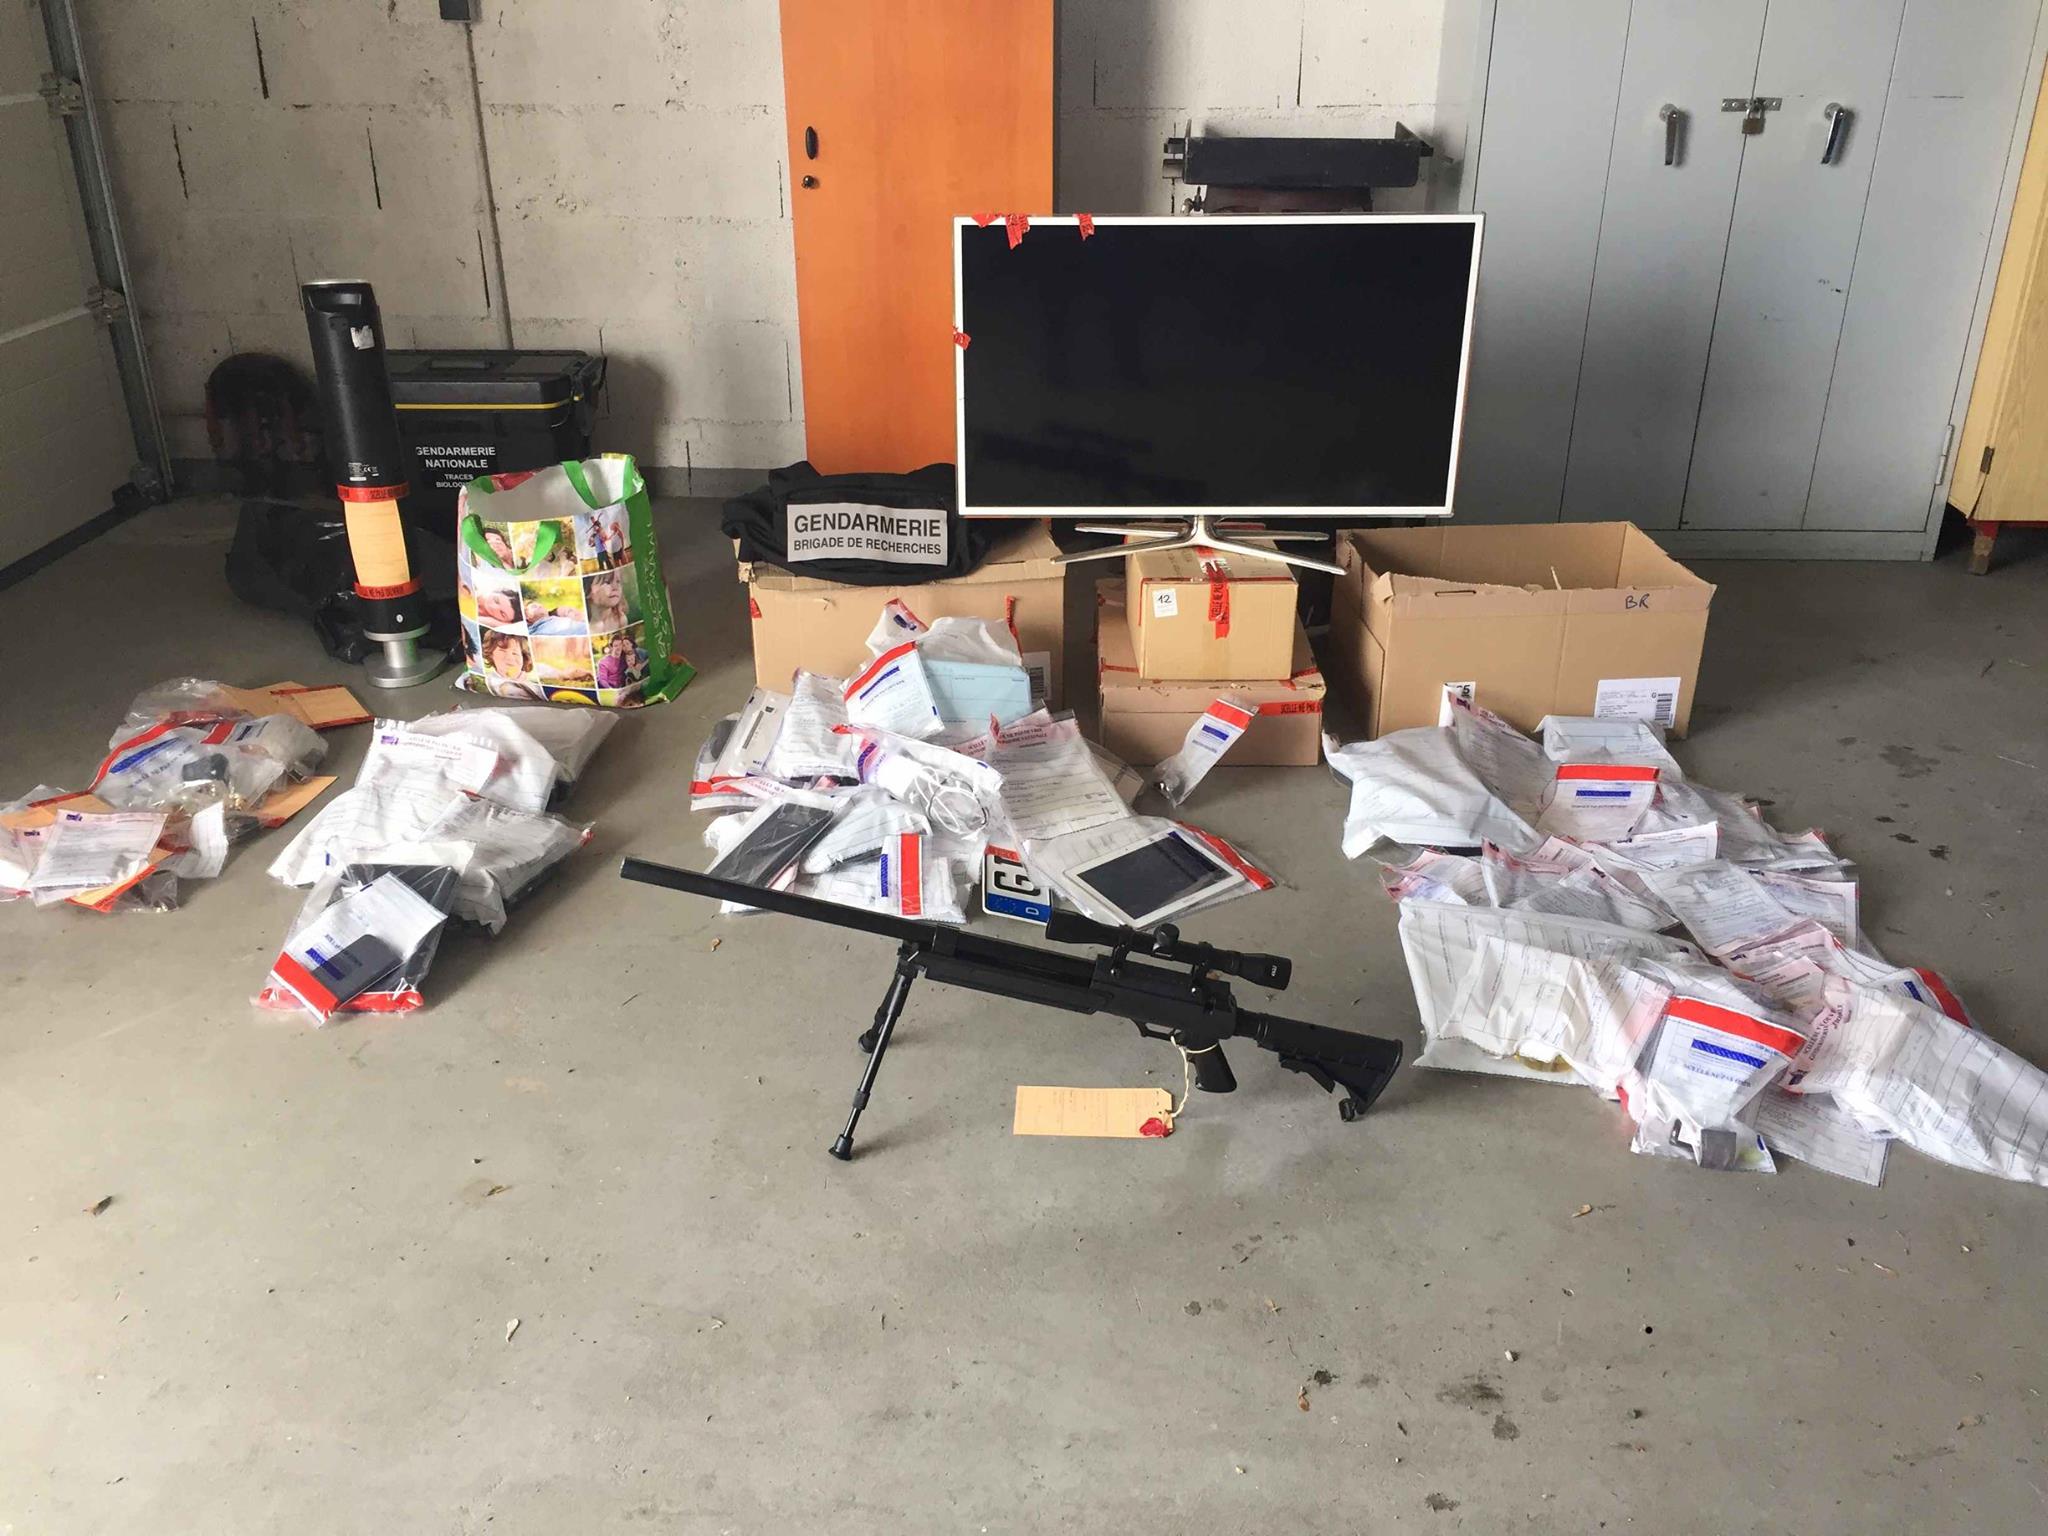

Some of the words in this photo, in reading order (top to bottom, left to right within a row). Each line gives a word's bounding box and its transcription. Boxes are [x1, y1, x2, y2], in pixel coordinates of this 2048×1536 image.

[416, 446, 496, 456] GENDARMERIE
[425, 459, 488, 468] NATIONALE
[794, 512, 942, 538] GENDARMERIE
[794, 537, 845, 551] BRIGADE
[847, 537, 863, 549] DE
[865, 538, 942, 555] RECHERCHES
[1158, 594, 1173, 604] 12
[1624, 593, 1650, 610] BR
[1025, 907, 1039, 916] D
